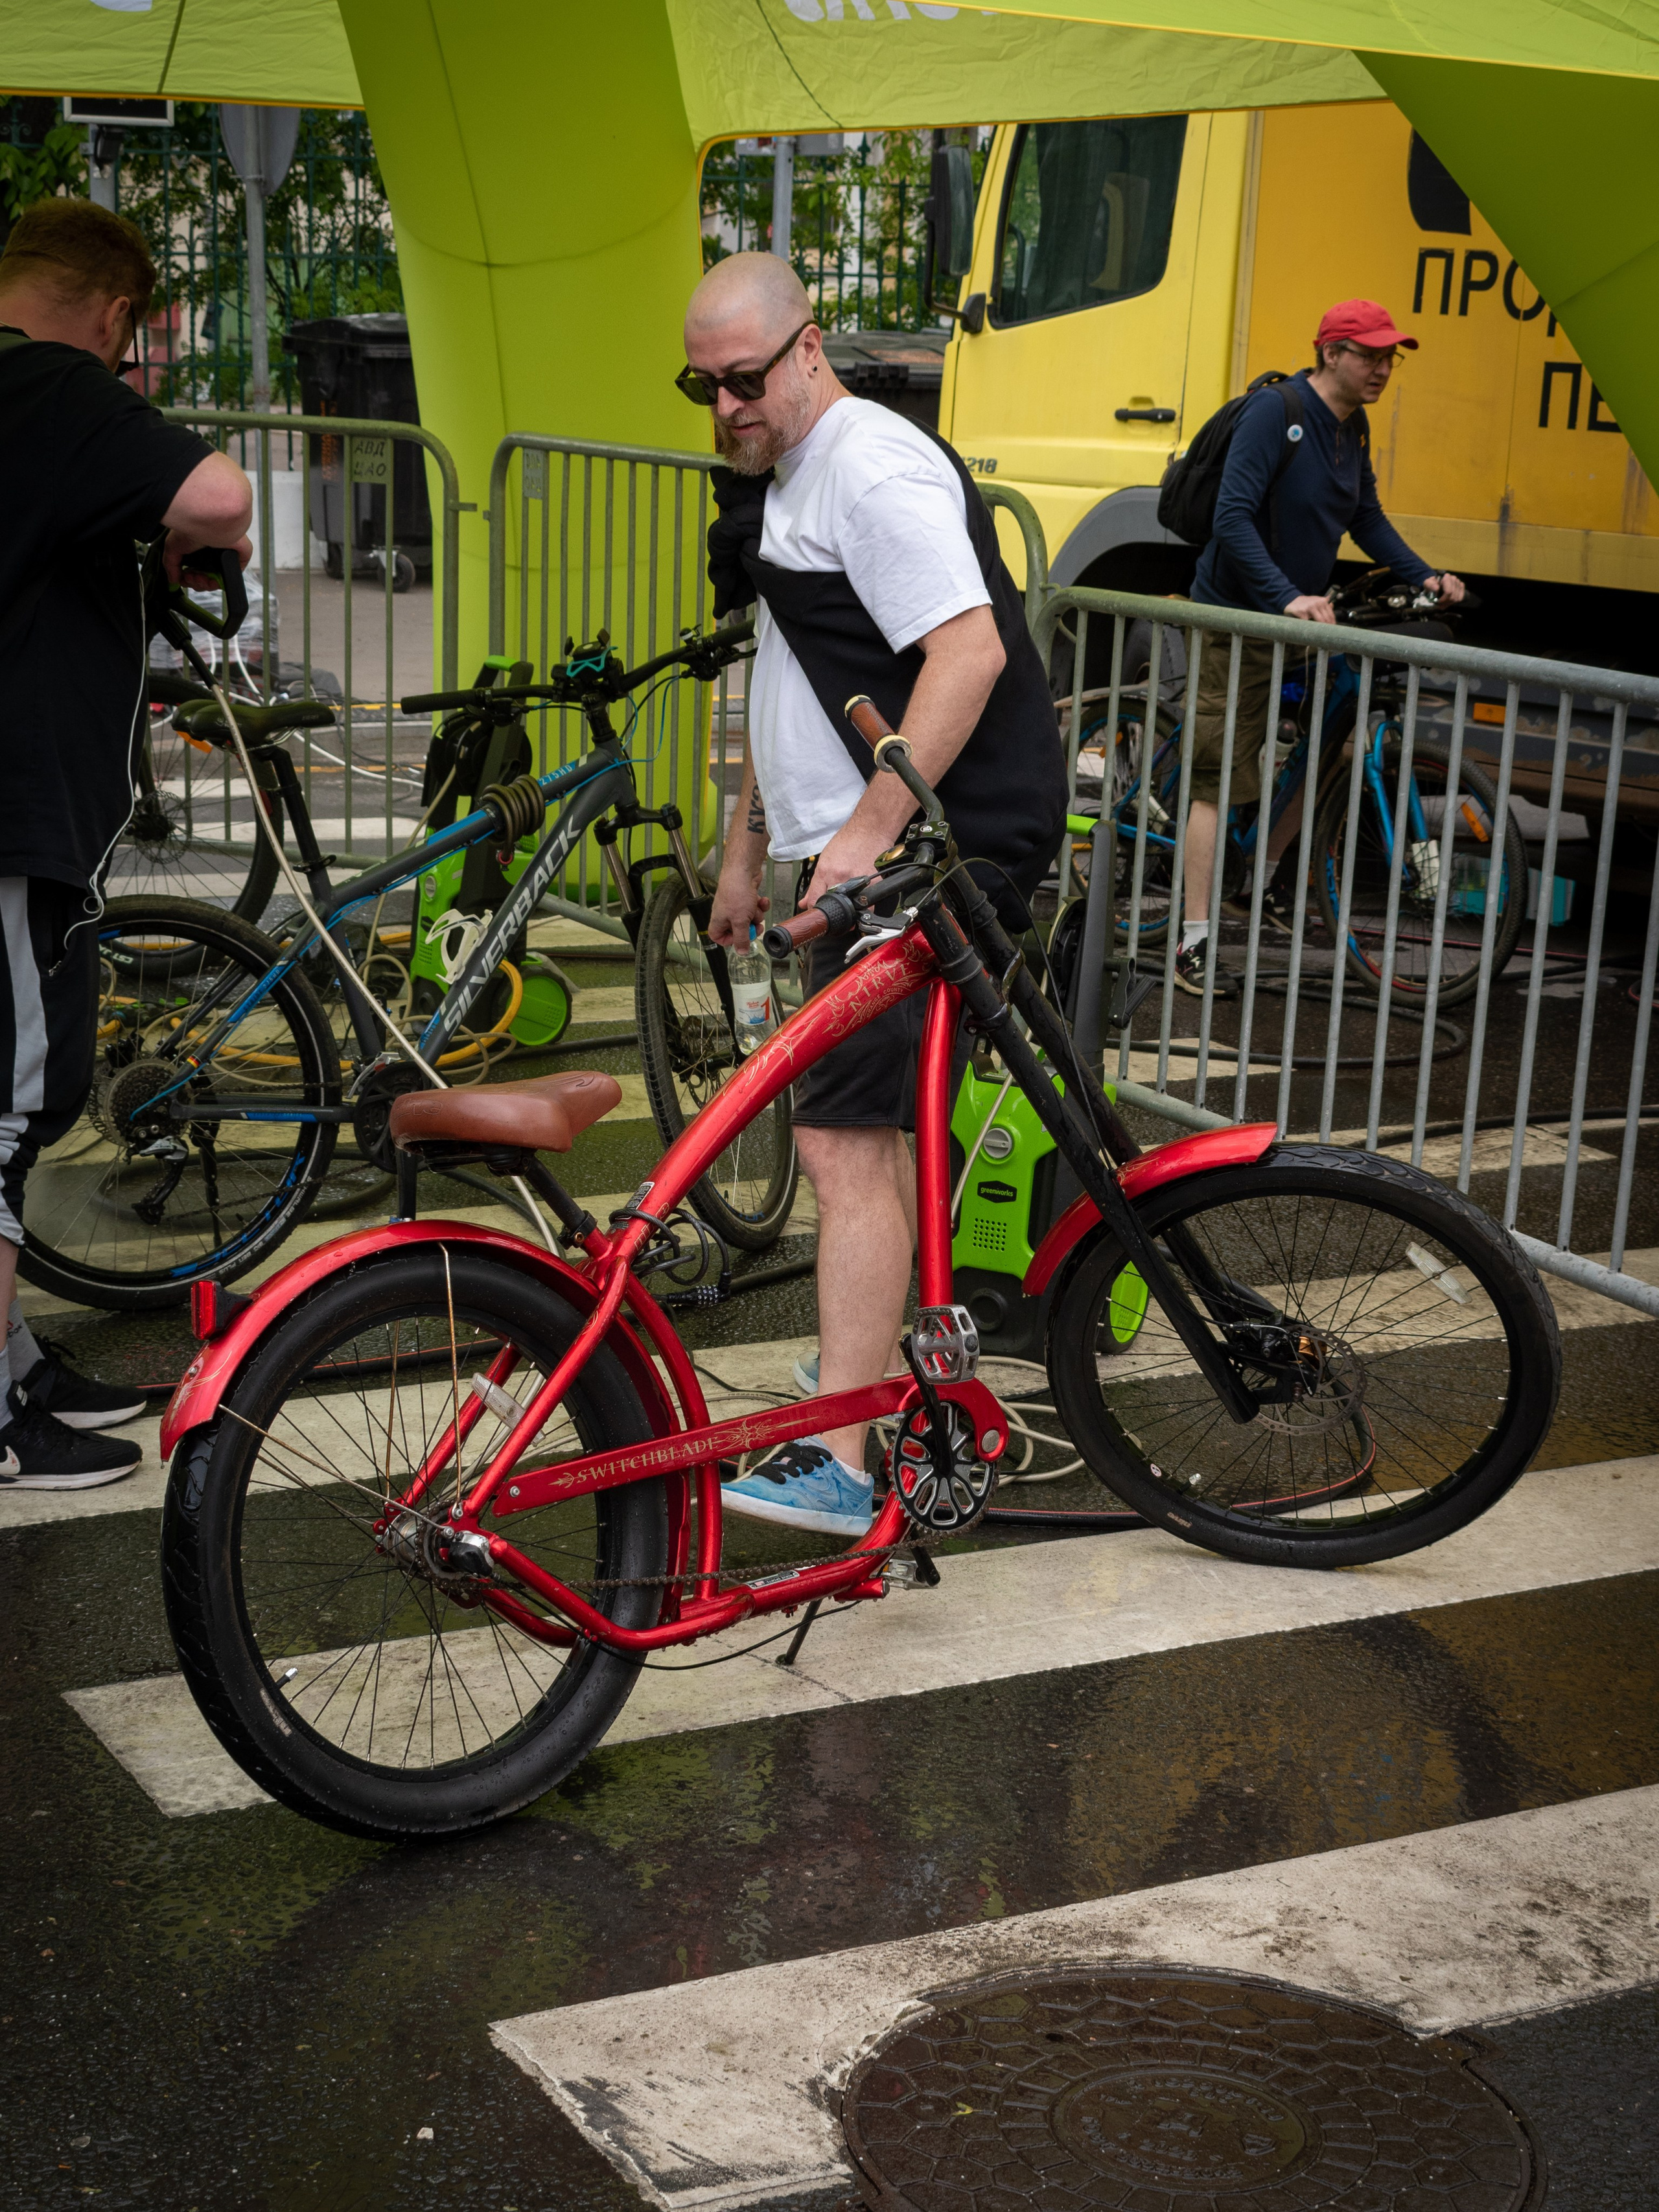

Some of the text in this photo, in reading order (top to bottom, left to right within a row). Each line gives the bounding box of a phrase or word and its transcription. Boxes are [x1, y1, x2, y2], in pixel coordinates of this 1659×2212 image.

[1413, 247, 1557, 337] ПРО
[962, 456, 997, 473] 218
[443, 814, 581, 1040] SILVERBACK
[848, 962, 910, 1012] NIRVE
[866, 994, 881, 1018] ORANGE
[980, 1187, 1014, 1197] greenworks
[577, 1436, 718, 1484] SWITCHBLADE
